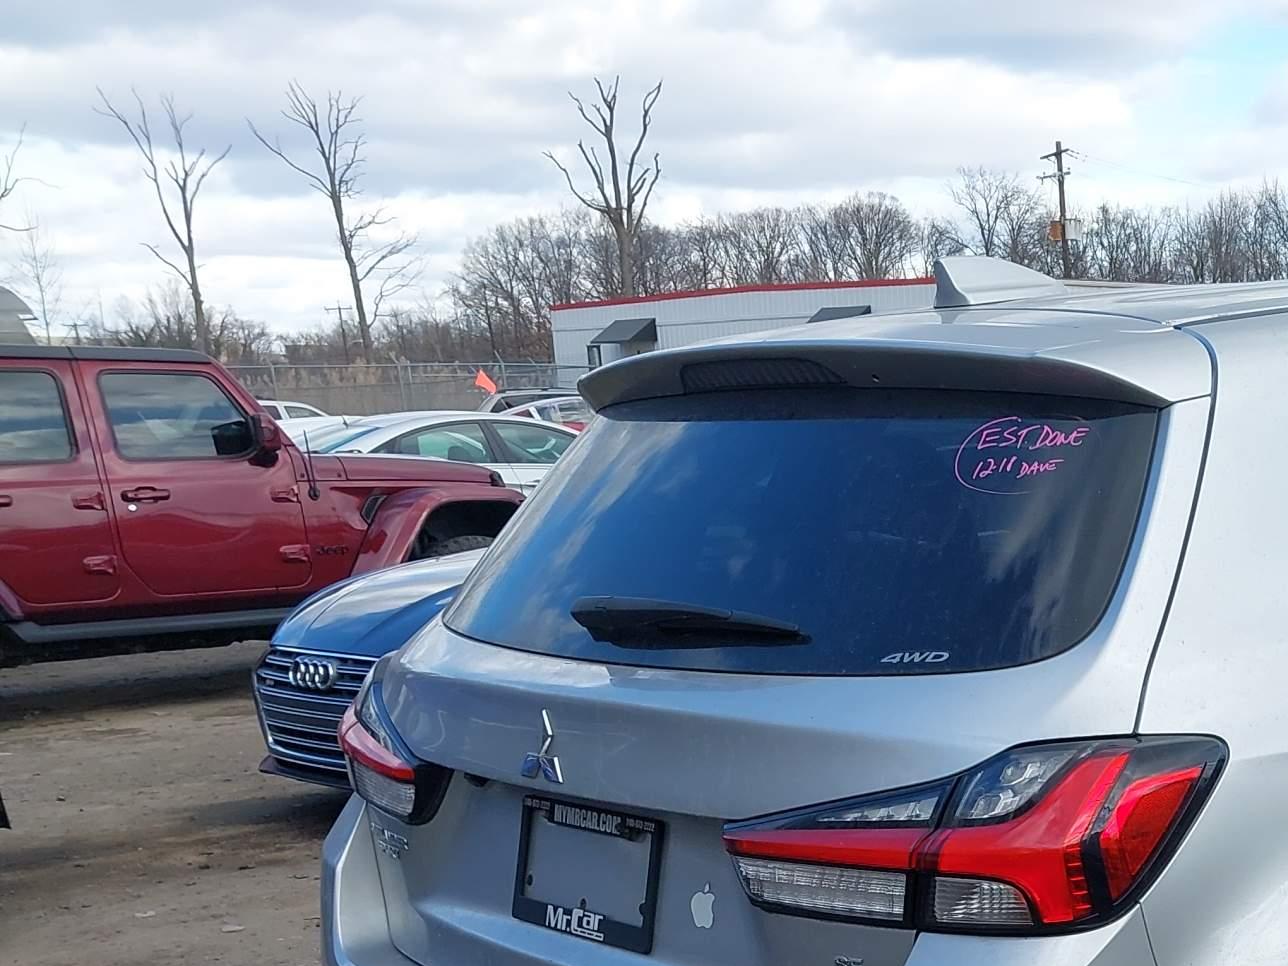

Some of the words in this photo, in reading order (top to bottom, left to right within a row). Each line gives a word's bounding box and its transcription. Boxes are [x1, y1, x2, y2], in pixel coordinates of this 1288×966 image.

[1028, 425, 1090, 450] DONE
[1016, 459, 1065, 479] DAVE
[880, 651, 950, 664] 4WD
